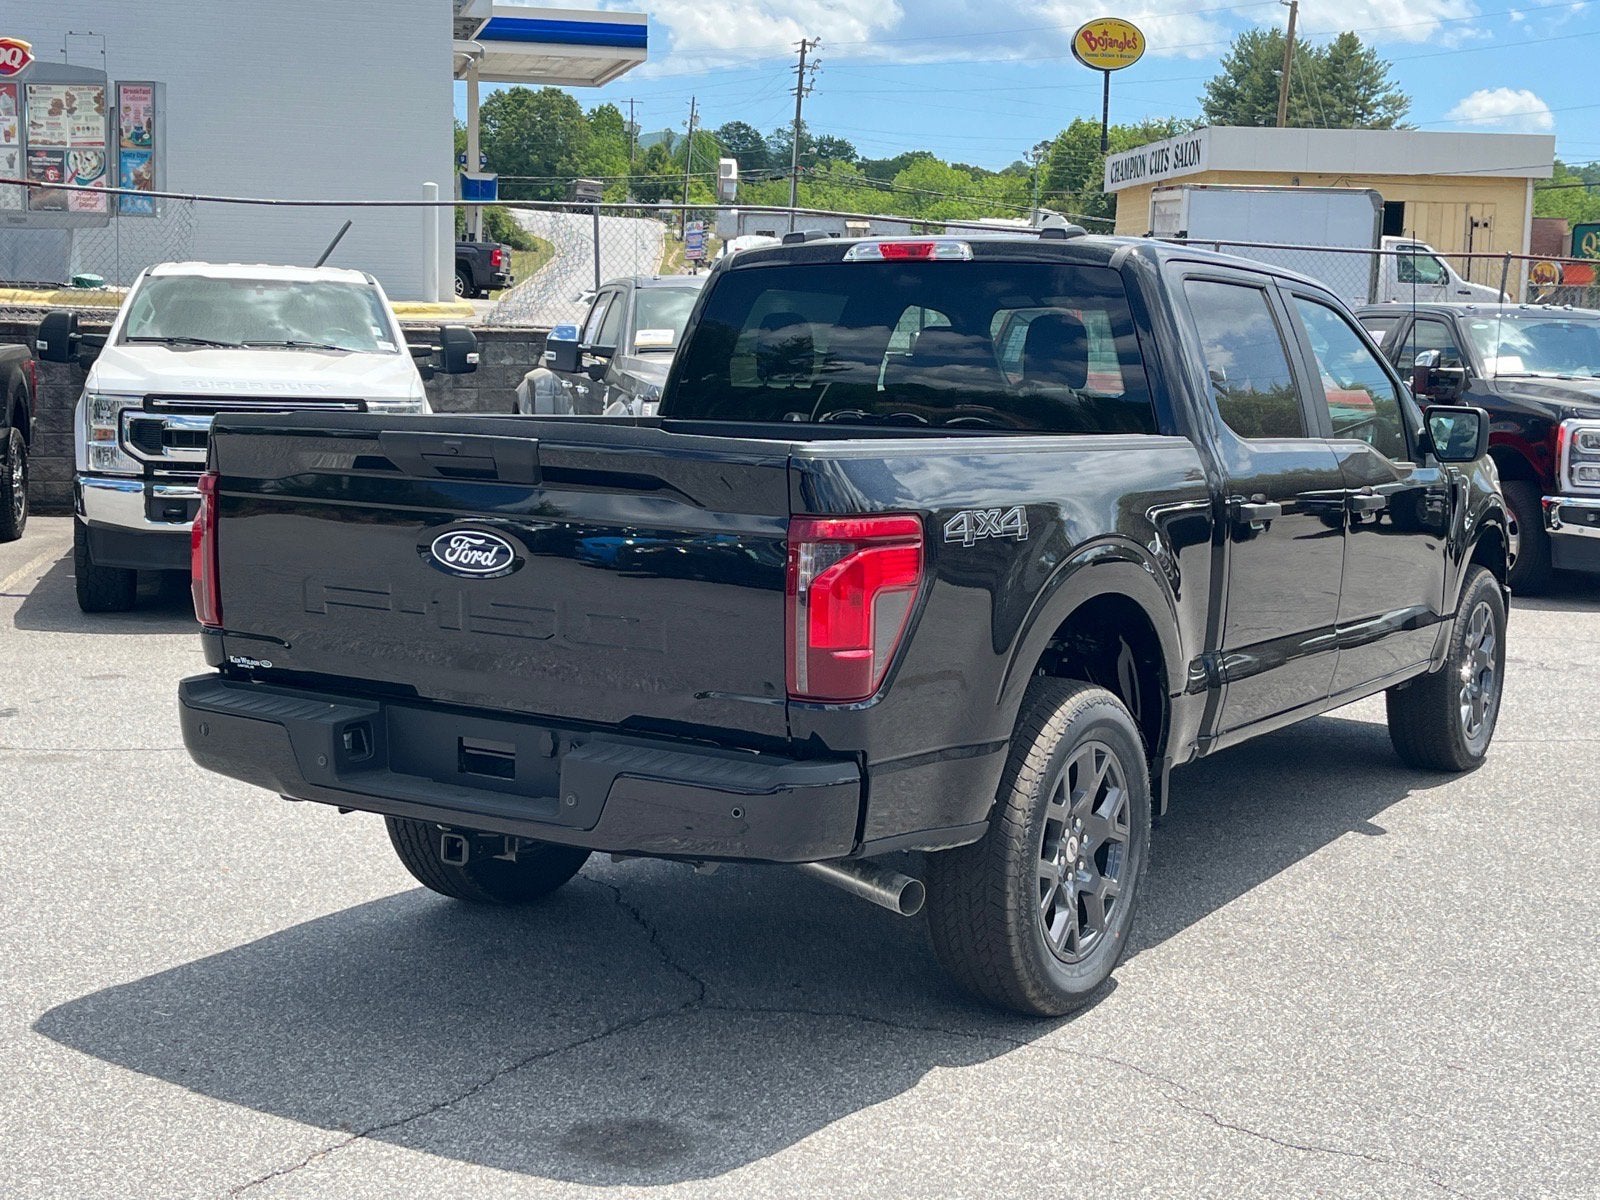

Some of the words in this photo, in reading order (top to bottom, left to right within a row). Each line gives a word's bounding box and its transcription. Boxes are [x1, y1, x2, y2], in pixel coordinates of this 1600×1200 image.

[1111, 154, 1147, 184] CHAMPION
[1149, 147, 1170, 175] CUTS
[1173, 139, 1201, 170] SALON
[181, 378, 264, 390] SUPER
[267, 381, 332, 393] DUTY
[445, 535, 499, 566] Ford
